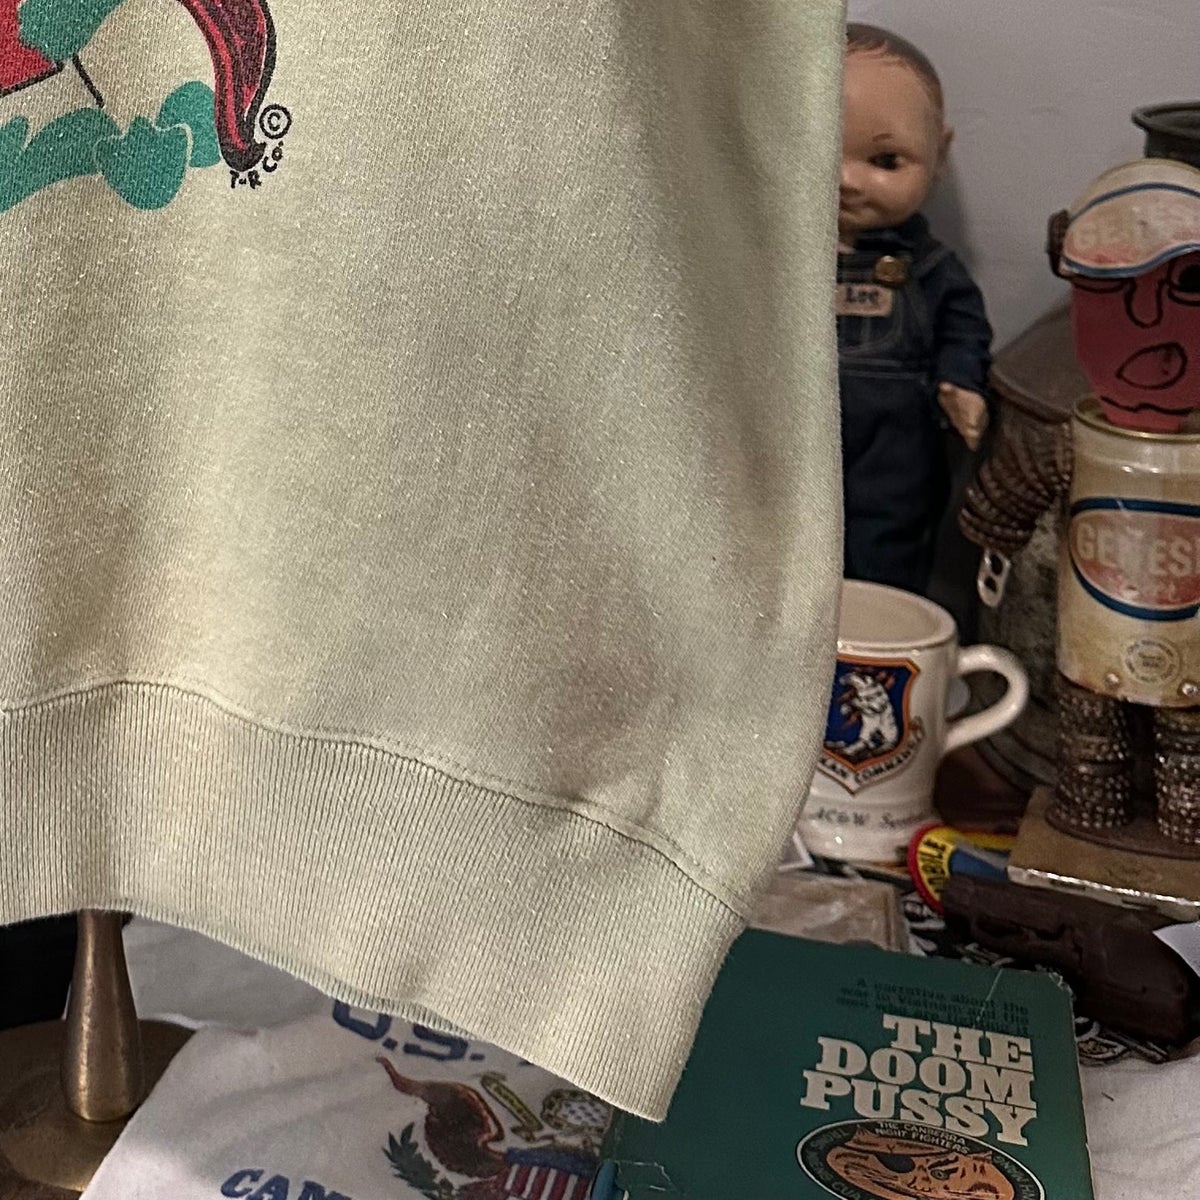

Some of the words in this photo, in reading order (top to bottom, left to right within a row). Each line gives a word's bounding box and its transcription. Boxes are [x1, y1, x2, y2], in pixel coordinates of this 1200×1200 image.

[845, 285, 880, 303] Lee
[883, 1013, 1032, 1067] THE
[816, 1036, 1034, 1105] DOOM
[800, 1069, 1037, 1147] PUSSY
[875, 1127, 907, 1139] NIGHT
[911, 1131, 971, 1155] FIGHTERS
[903, 1124, 966, 1145] CANBERRA
